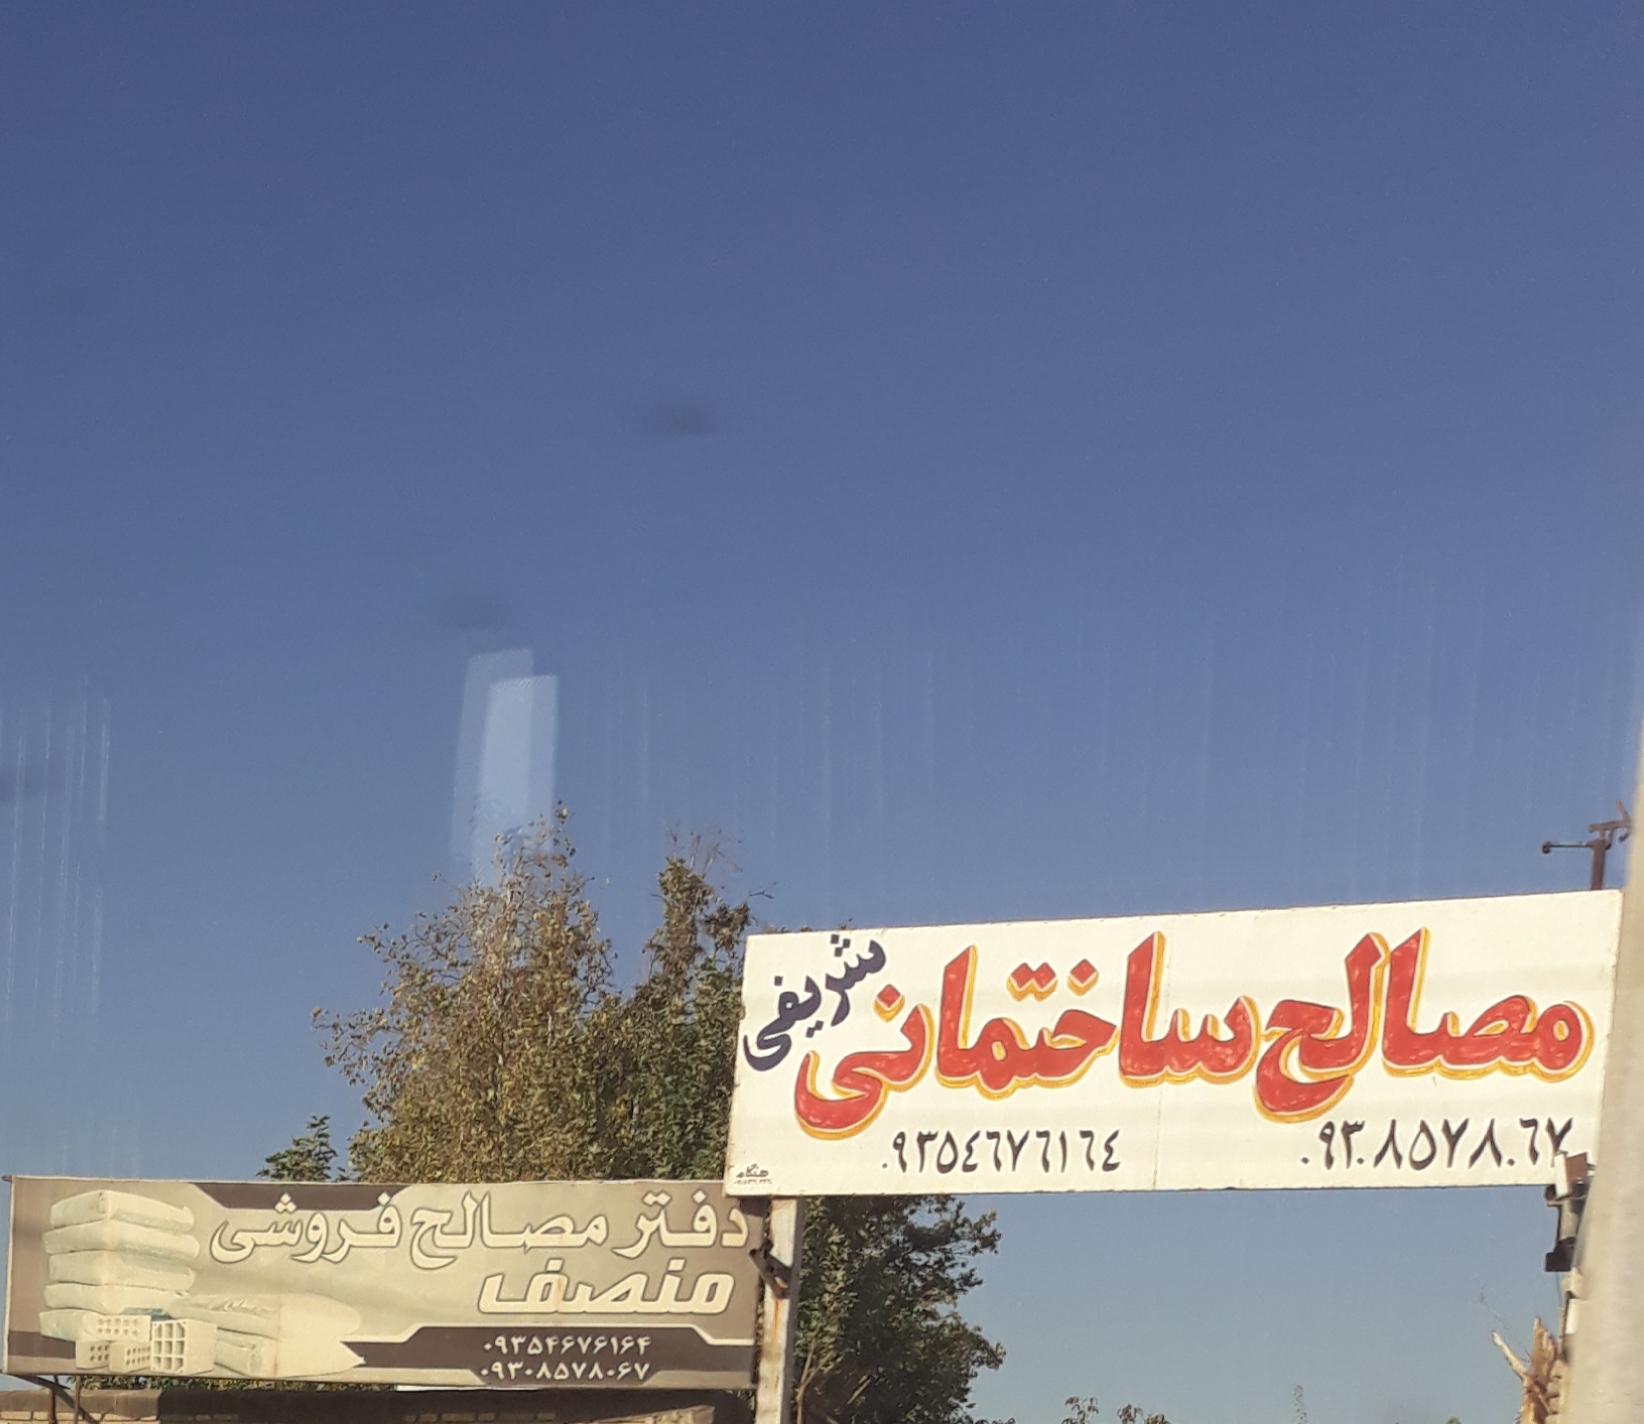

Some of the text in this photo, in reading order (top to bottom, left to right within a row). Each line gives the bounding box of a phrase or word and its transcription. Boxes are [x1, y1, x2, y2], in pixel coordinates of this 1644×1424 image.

[743, 927, 1595, 1140] مصالح ساختمانی شریفی
[210, 1189, 749, 1271] دفتر مصالح فروشی
[477, 1258, 736, 1315] منصف
